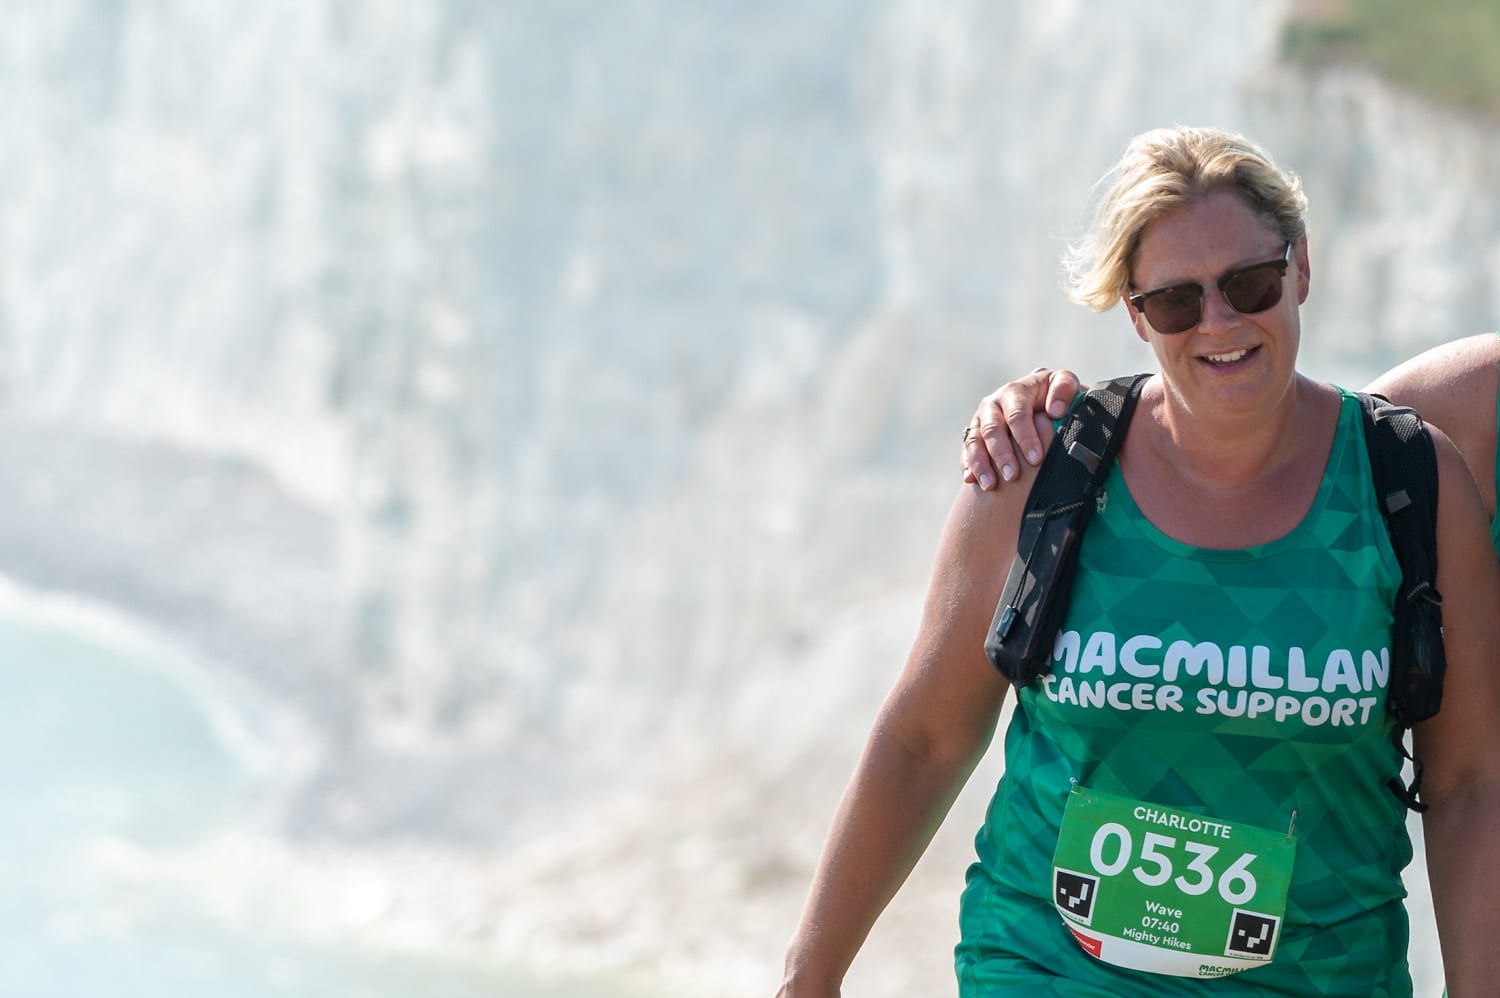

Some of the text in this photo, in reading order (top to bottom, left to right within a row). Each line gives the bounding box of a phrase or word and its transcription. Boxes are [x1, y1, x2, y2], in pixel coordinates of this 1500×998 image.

[1045, 629, 1390, 694] MACMILLAN
[1041, 673, 1378, 728] CANCER SUPPORT
[1133, 805, 1233, 840] CHARLOTTE
[1089, 821, 1258, 906] 0536
[1141, 915, 1180, 934] 07:40
[1145, 899, 1183, 919] Wave
[1122, 927, 1192, 950] Mighty Hikes
